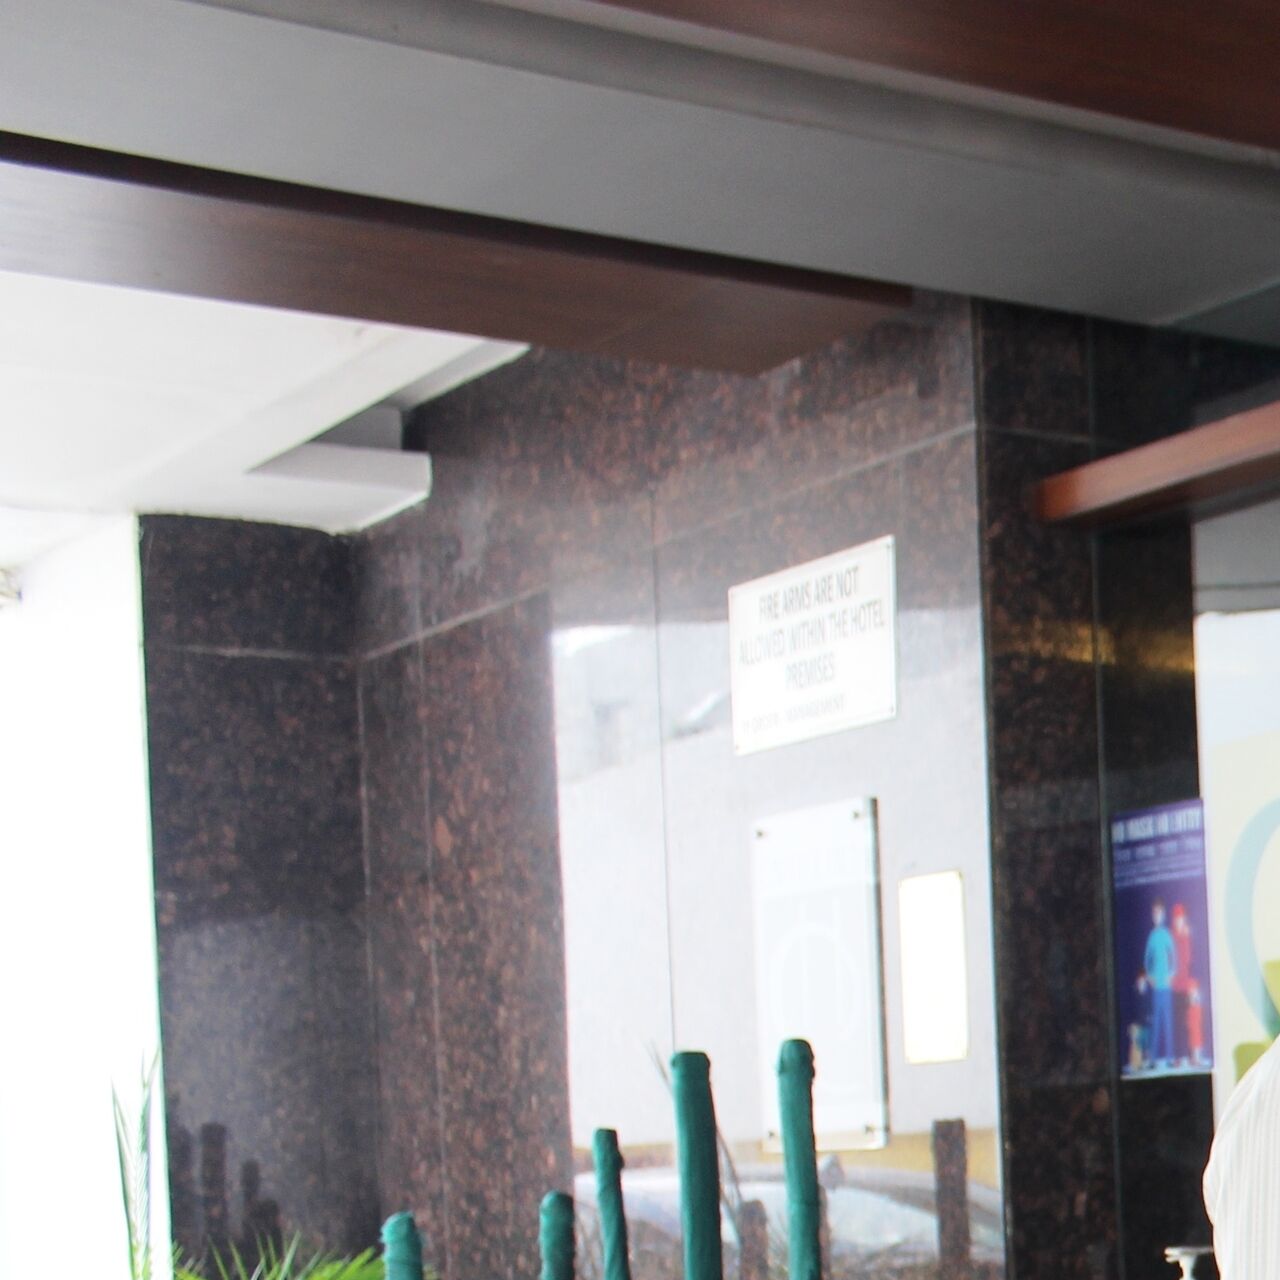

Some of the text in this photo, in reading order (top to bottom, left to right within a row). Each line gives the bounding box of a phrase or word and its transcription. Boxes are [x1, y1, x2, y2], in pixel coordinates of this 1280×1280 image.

[759, 566, 859, 623] FIRE ARMS ARE NOT
[739, 600, 885, 666] ALLOWED WITHIN THE HOTEL
[786, 654, 834, 689] PREMISES
